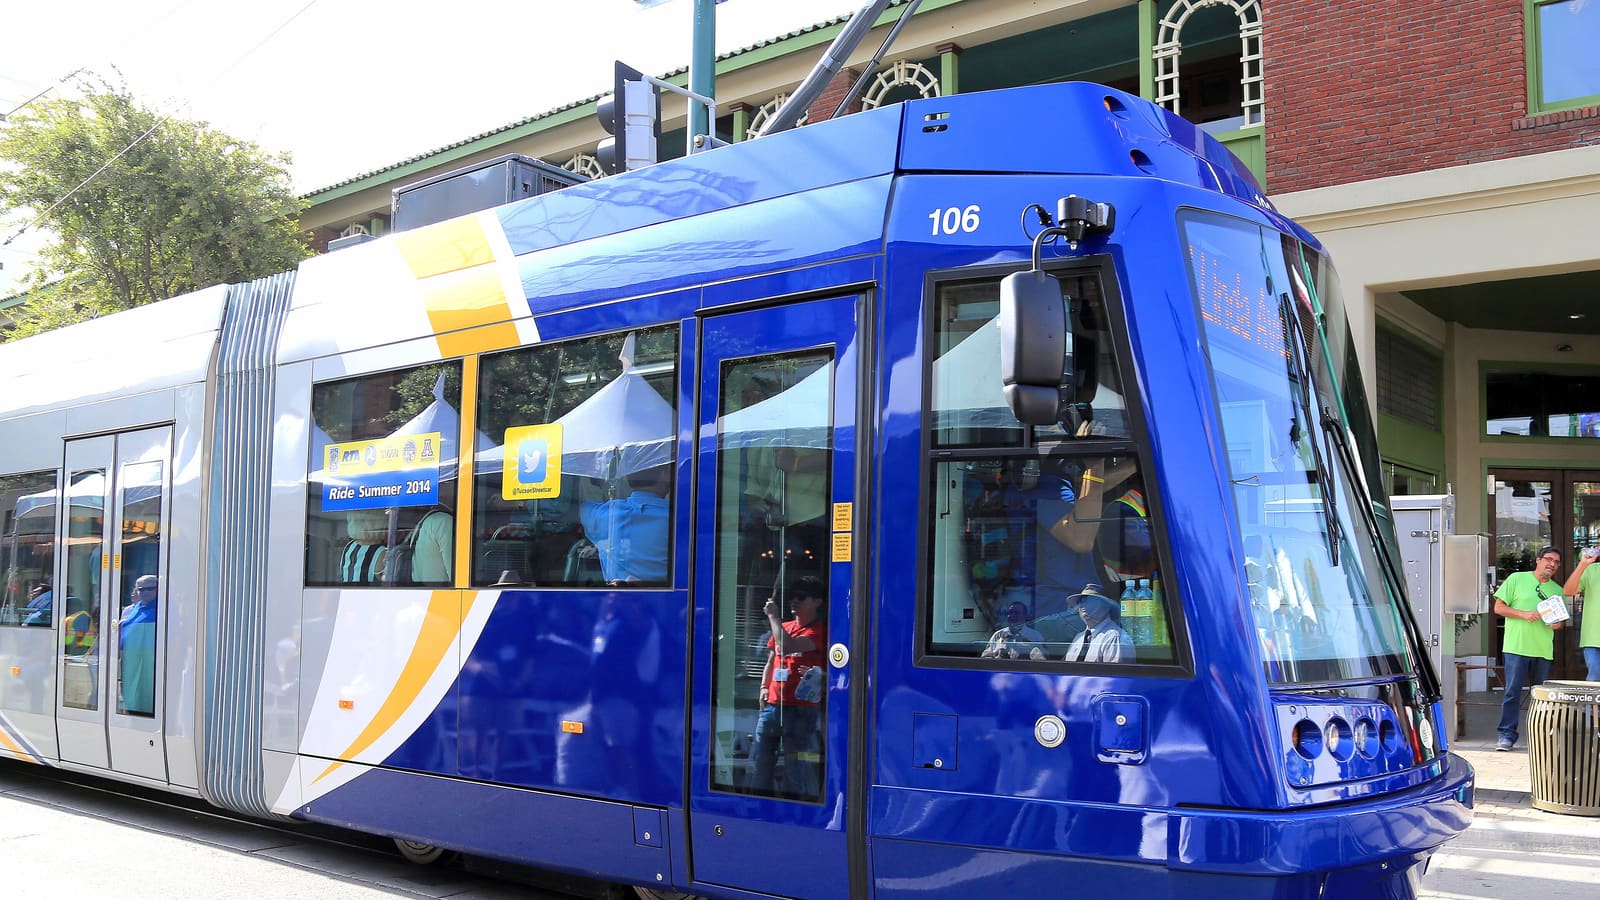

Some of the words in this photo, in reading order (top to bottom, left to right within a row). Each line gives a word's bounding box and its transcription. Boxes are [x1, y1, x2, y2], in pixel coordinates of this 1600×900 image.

[928, 204, 981, 236] 106
[1201, 252, 1251, 342] Linda
[328, 486, 355, 501] Ride
[358, 484, 402, 498] Summer
[406, 479, 431, 495] 2014
[1557, 692, 1593, 703] Recycle
